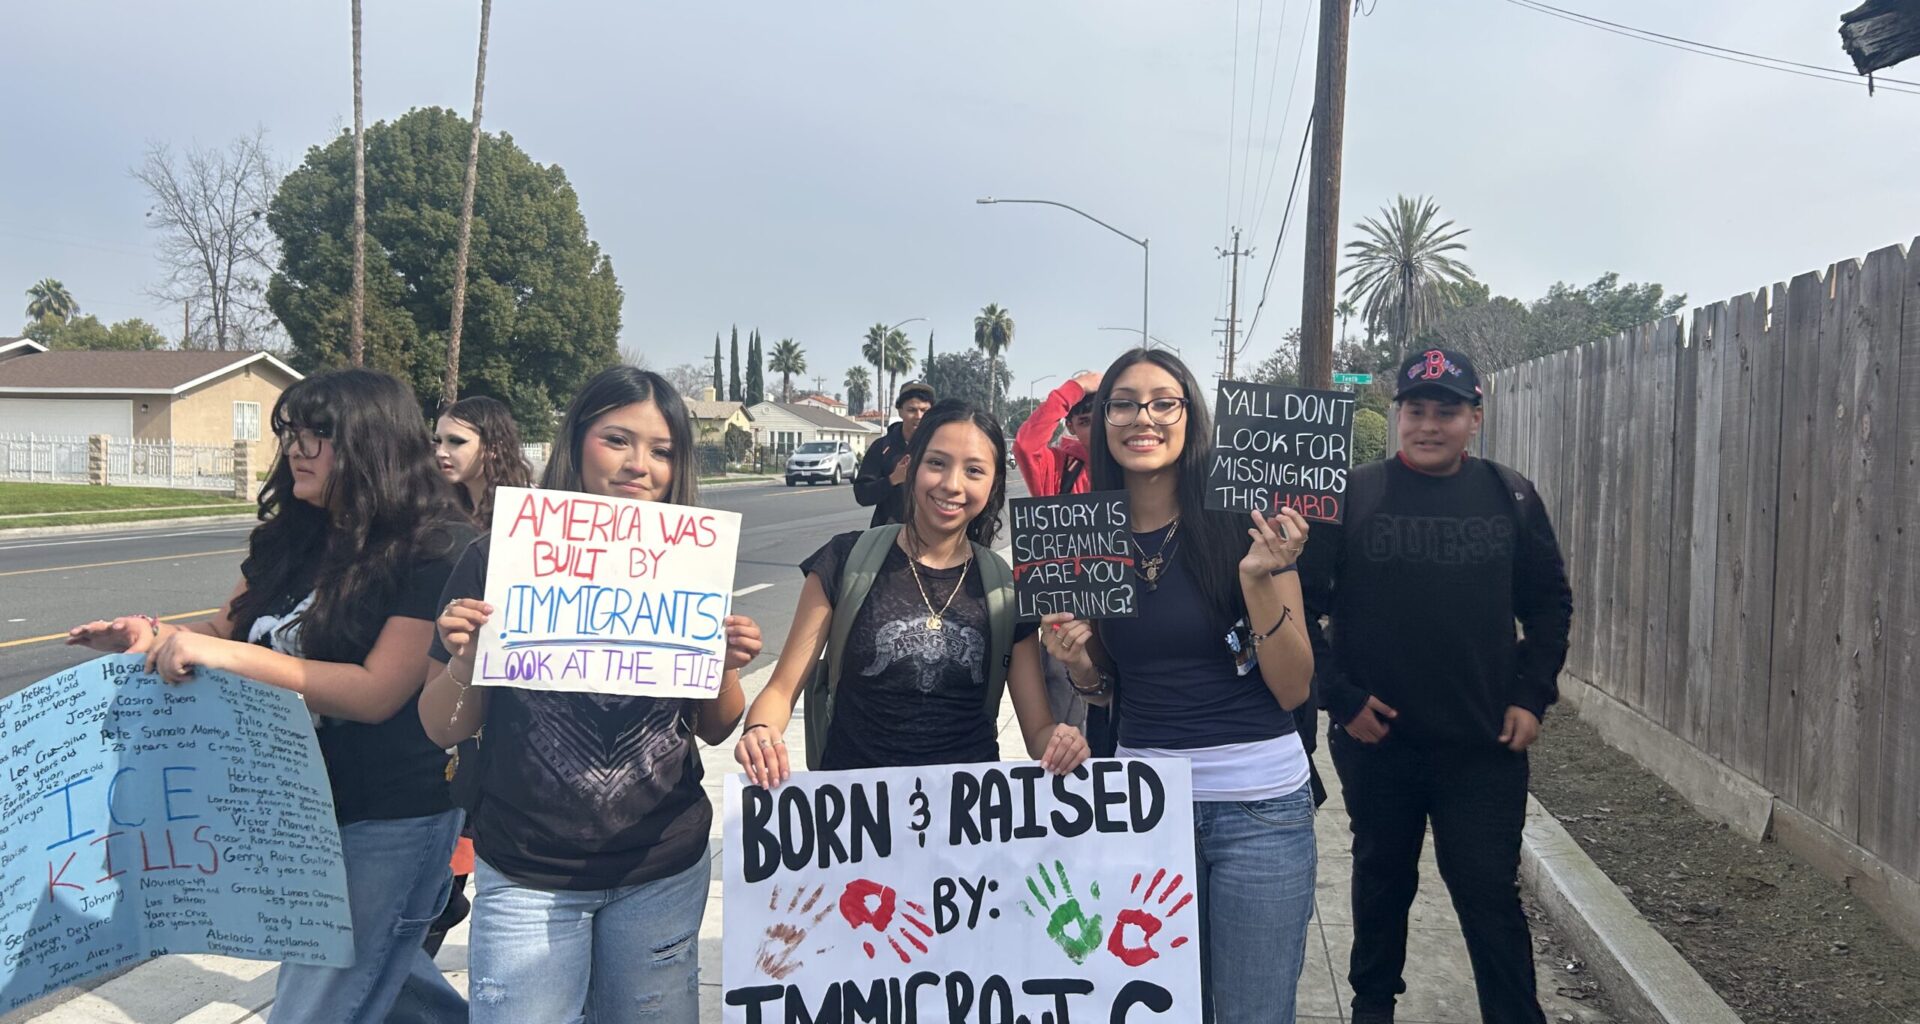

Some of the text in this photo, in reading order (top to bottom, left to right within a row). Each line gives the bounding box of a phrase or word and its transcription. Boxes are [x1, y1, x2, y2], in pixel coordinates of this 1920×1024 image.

[1420, 350, 1446, 380] B
[1222, 387, 1354, 427] YALL DONT
[1216, 424, 1346, 461] LOOK FOR
[1211, 455, 1347, 493] MISSING KIDS
[509, 493, 717, 547] AMERICA WAS
[1014, 501, 1126, 531] HISTORY IS
[1215, 486, 1339, 521] THIS HARD
[1015, 530, 1129, 563] SCREAMING
[1363, 513, 1513, 563] GUESS
[533, 541, 667, 580] BUILT BY
[1027, 564, 1075, 585] ARE
[1081, 561, 1124, 583] YOU
[1018, 584, 1134, 617] LISTENING?
[64, 680, 79, 692] old
[102, 662, 146, 680] Hasa
[482, 649, 723, 690] LOOK AT THE FILES
[111, 709, 142, 721] years
[153, 706, 172, 716] old
[100, 726, 131, 746] Pete
[133, 742, 168, 755] years
[177, 739, 196, 749] old
[10, 764, 29, 782] Leo
[33, 760, 58, 781] years
[61, 748, 77, 762] old
[43, 766, 200, 850] ICE
[742, 779, 892, 883] BORN
[948, 759, 1165, 846] RAISED
[48, 825, 219, 903] KILLS
[79, 888, 125, 912] Johnny
[932, 875, 1001, 934] BY:
